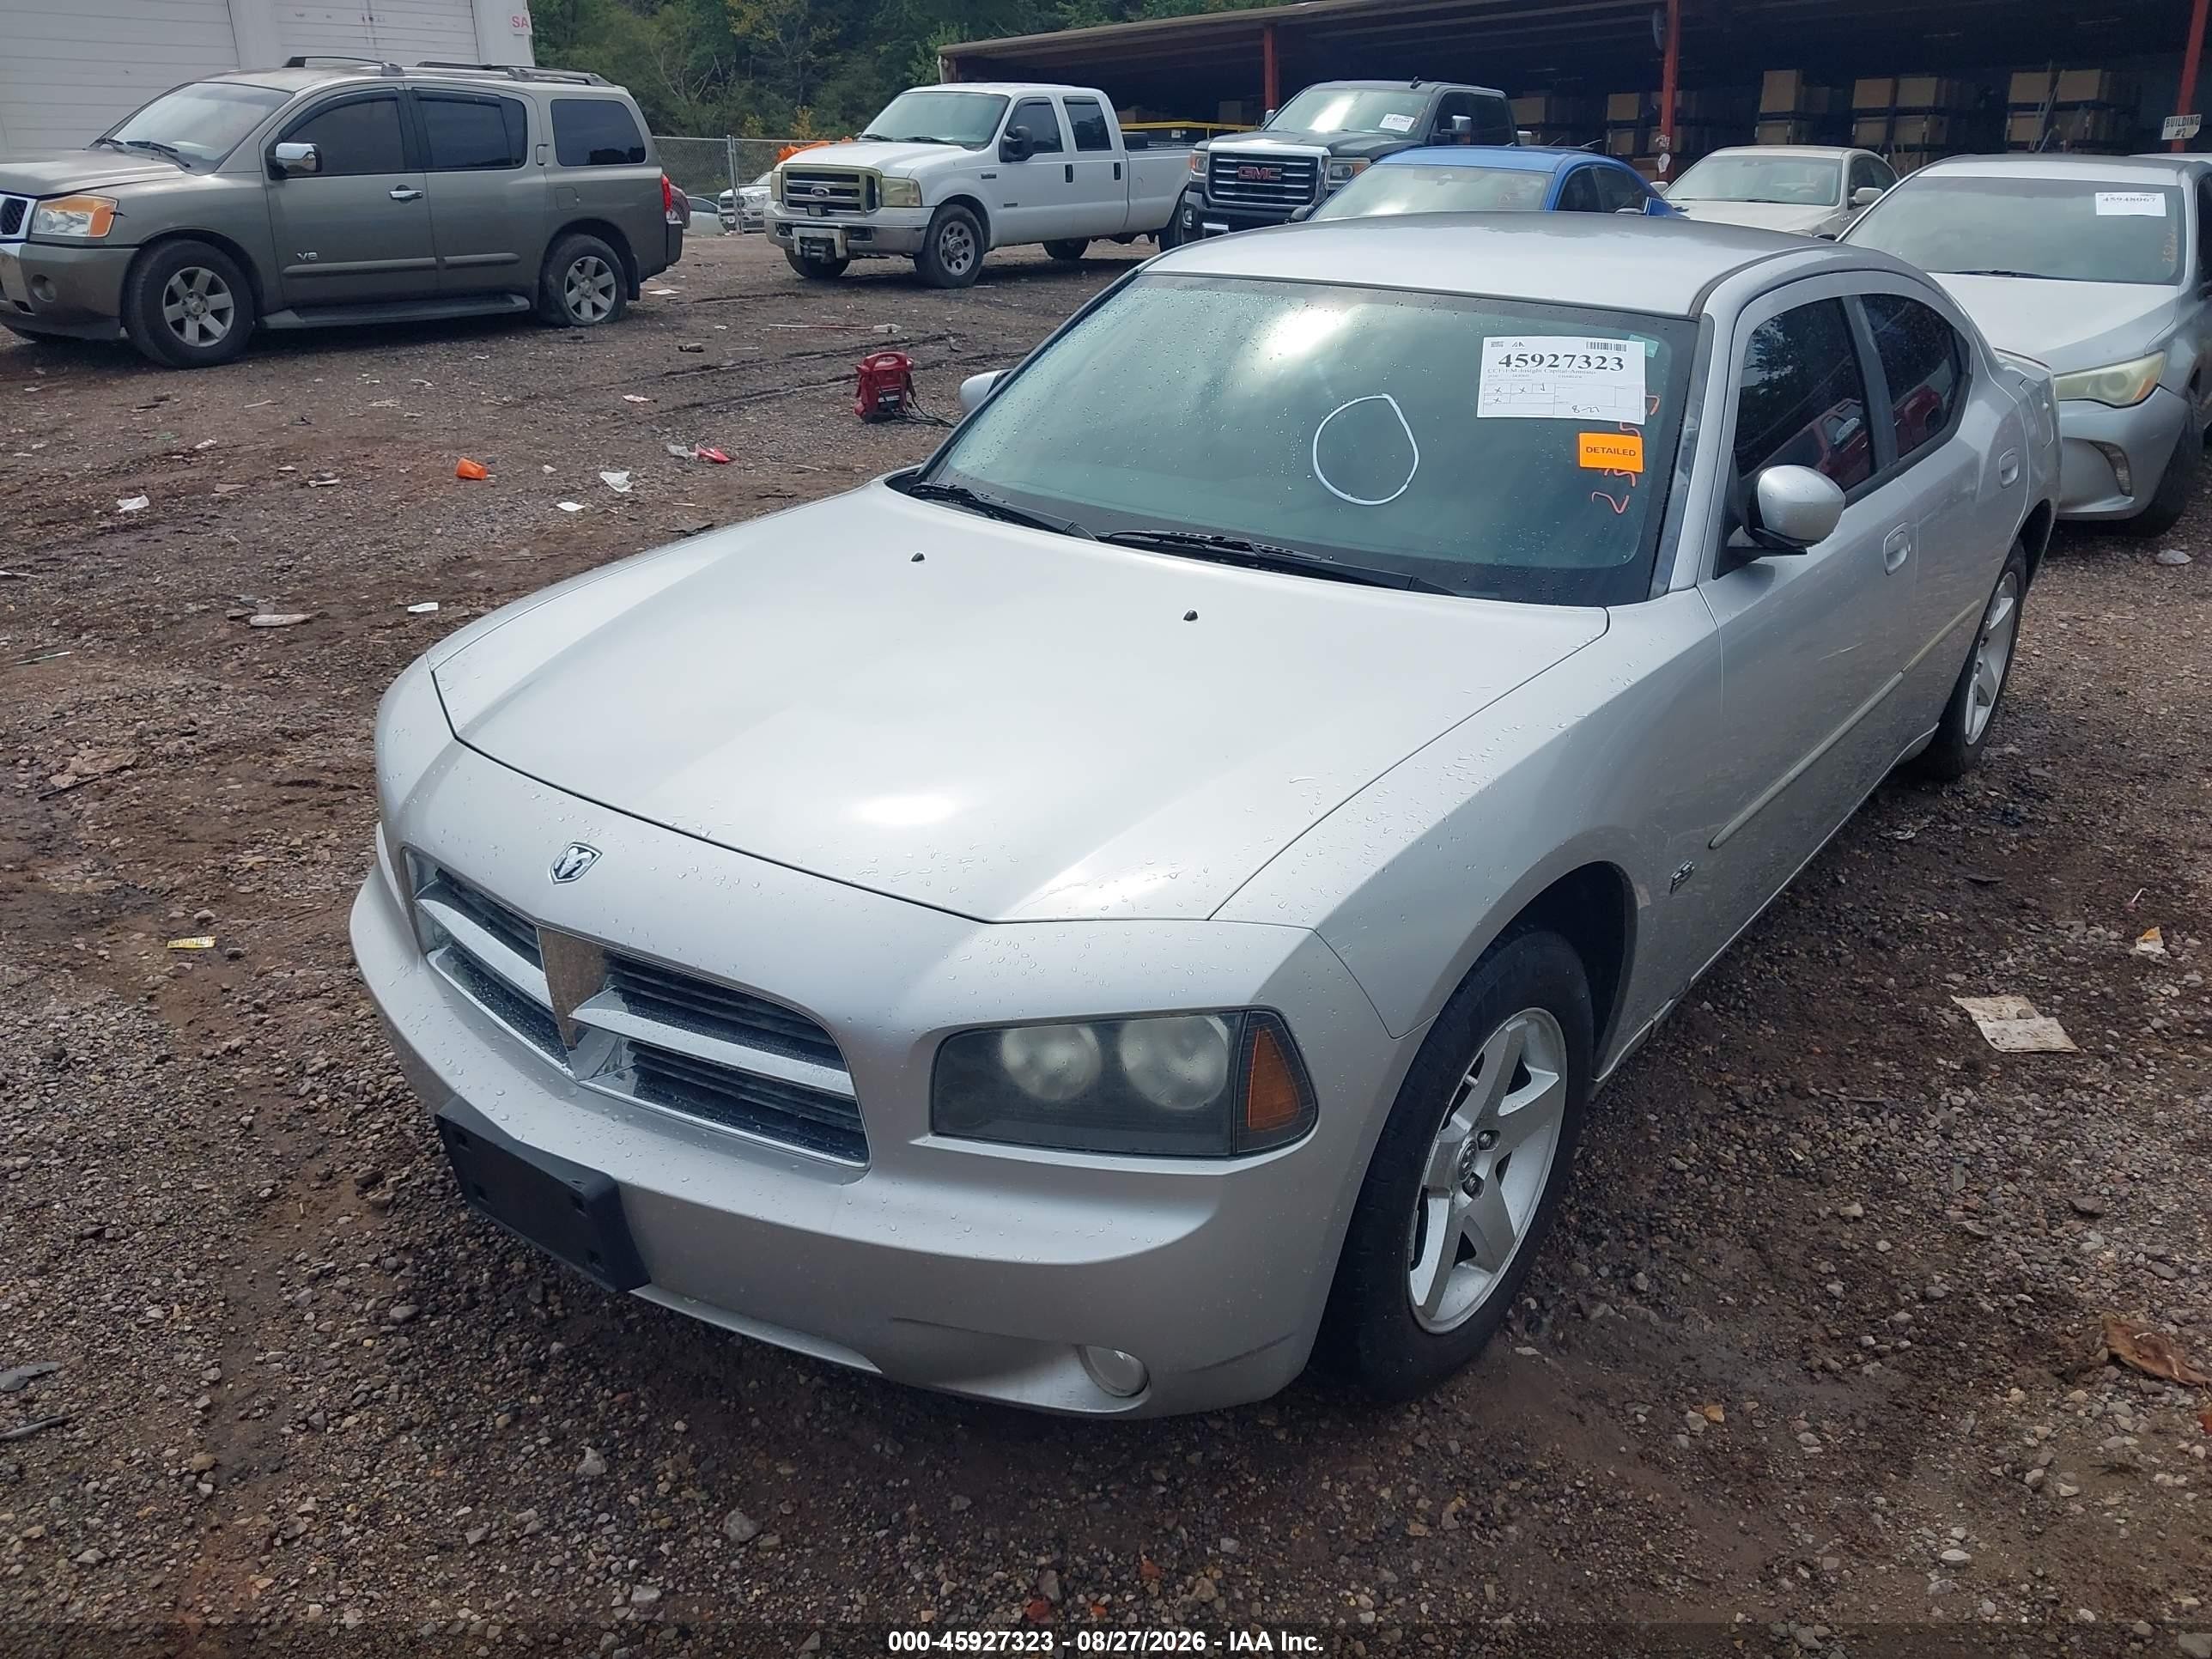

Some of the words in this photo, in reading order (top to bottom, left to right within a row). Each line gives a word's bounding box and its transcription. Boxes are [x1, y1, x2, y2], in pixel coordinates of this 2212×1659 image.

[2166, 116, 2200, 128] BUILDING
[2175, 128, 2186, 137] #2
[1237, 166, 1282, 181] GMC
[1498, 353, 1624, 372] 45927323
[1571, 404, 1600, 414] 8-27
[1585, 446, 1637, 457] DETAILED
